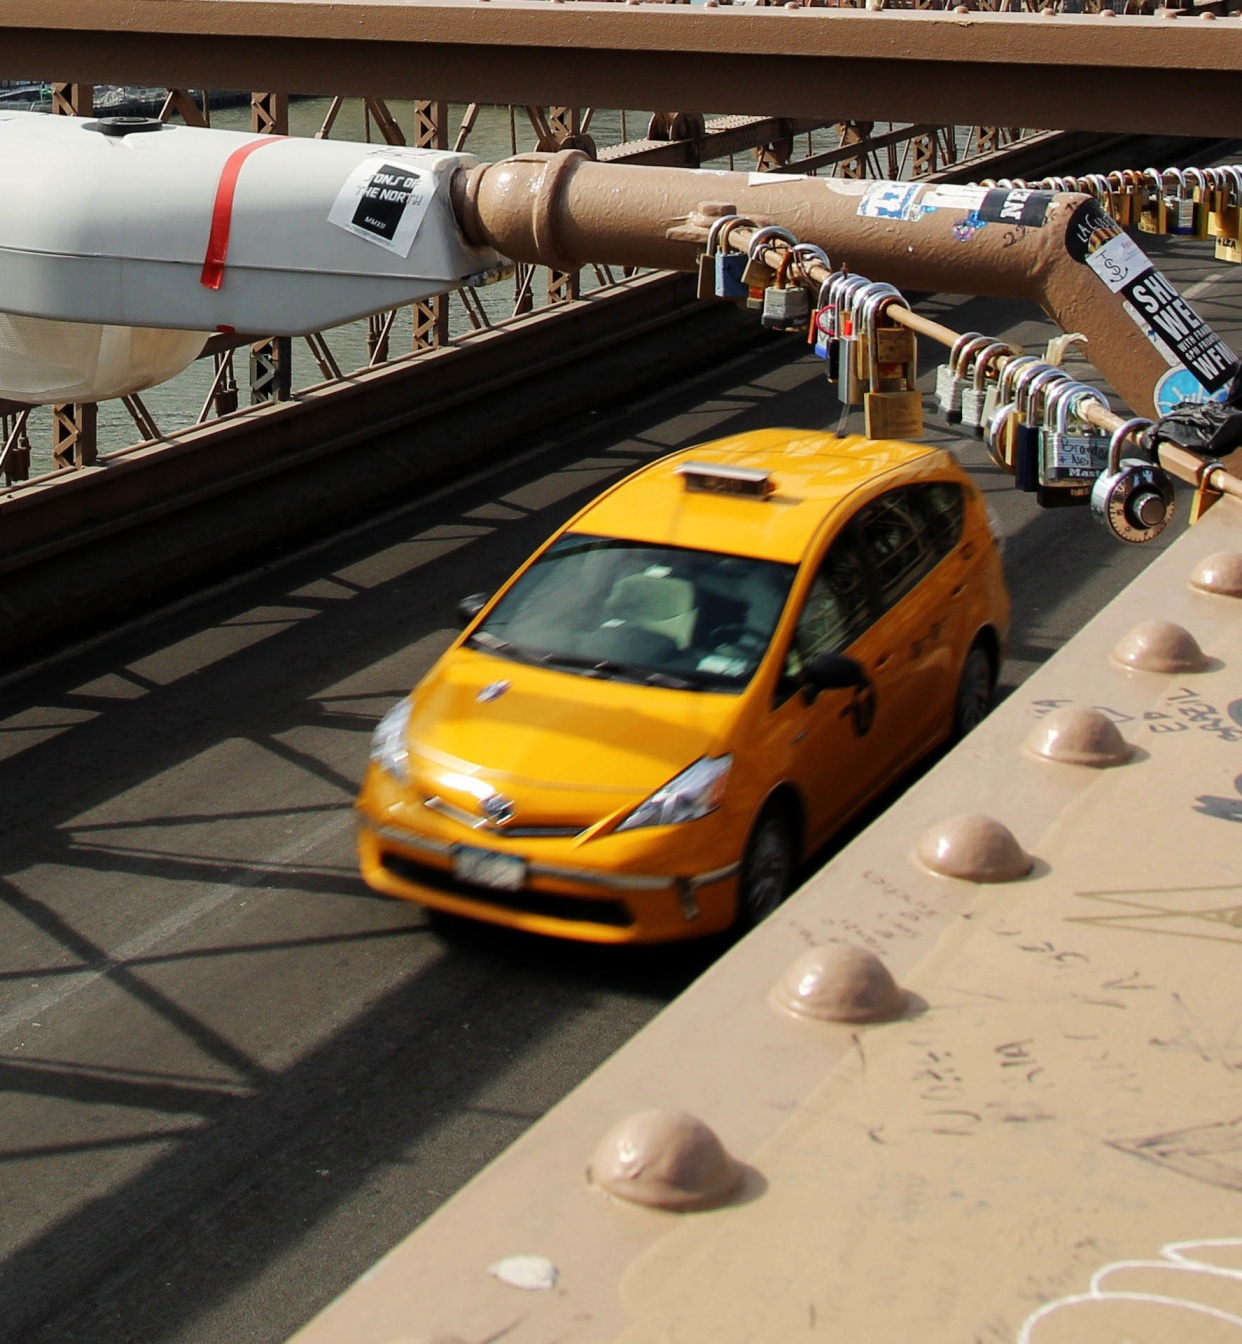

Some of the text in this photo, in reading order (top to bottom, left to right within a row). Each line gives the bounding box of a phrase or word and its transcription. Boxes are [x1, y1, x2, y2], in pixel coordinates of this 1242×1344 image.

[364, 173, 421, 189] SONS OF
[356, 186, 423, 206] THE NORTH
[1177, 335, 1197, 352] WITH
